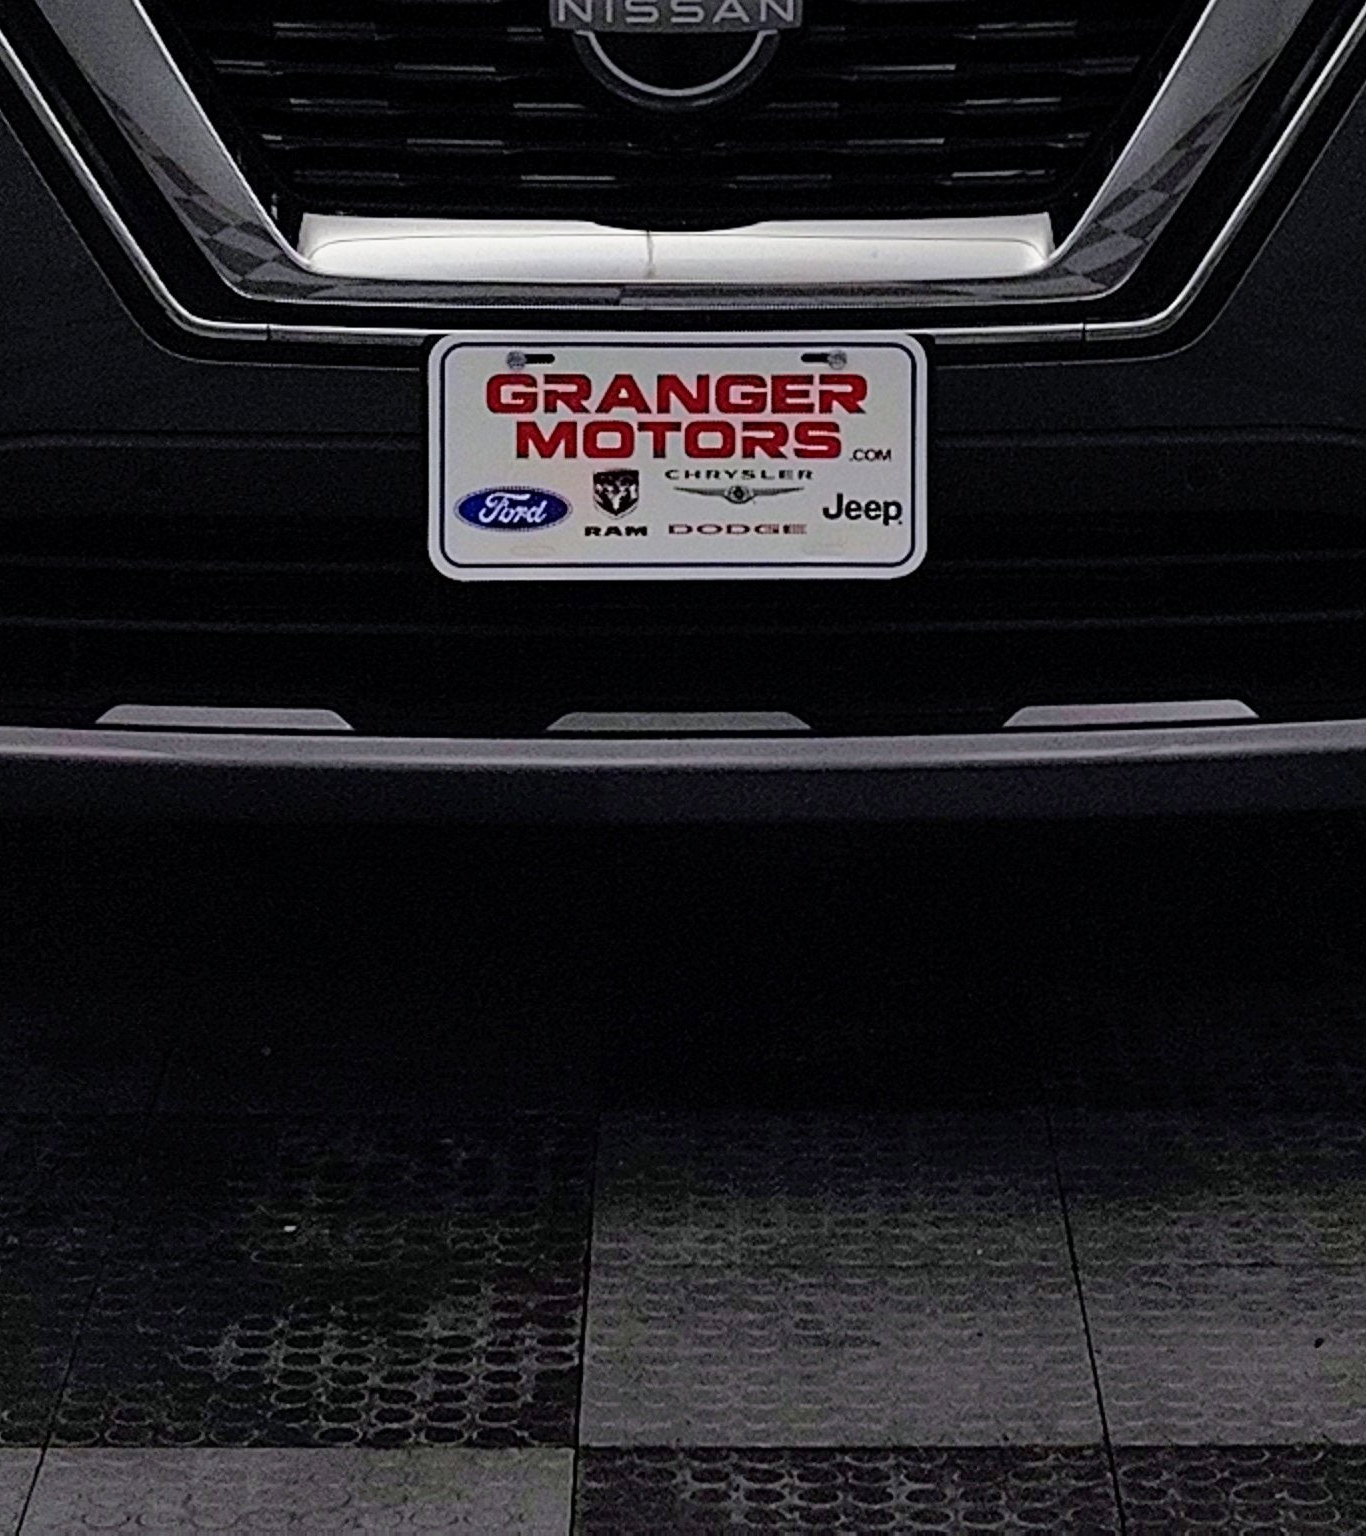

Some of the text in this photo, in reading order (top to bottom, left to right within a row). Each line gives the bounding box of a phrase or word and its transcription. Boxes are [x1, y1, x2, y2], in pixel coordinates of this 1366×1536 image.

[486, 374, 868, 414] GRANGER
[515, 421, 842, 459] MOTORS
[664, 469, 814, 480] CHRYSLER
[478, 492, 548, 524] Ford
[822, 493, 903, 526] Jeep
[584, 526, 648, 537] RAM
[668, 523, 808, 536] DODGE
